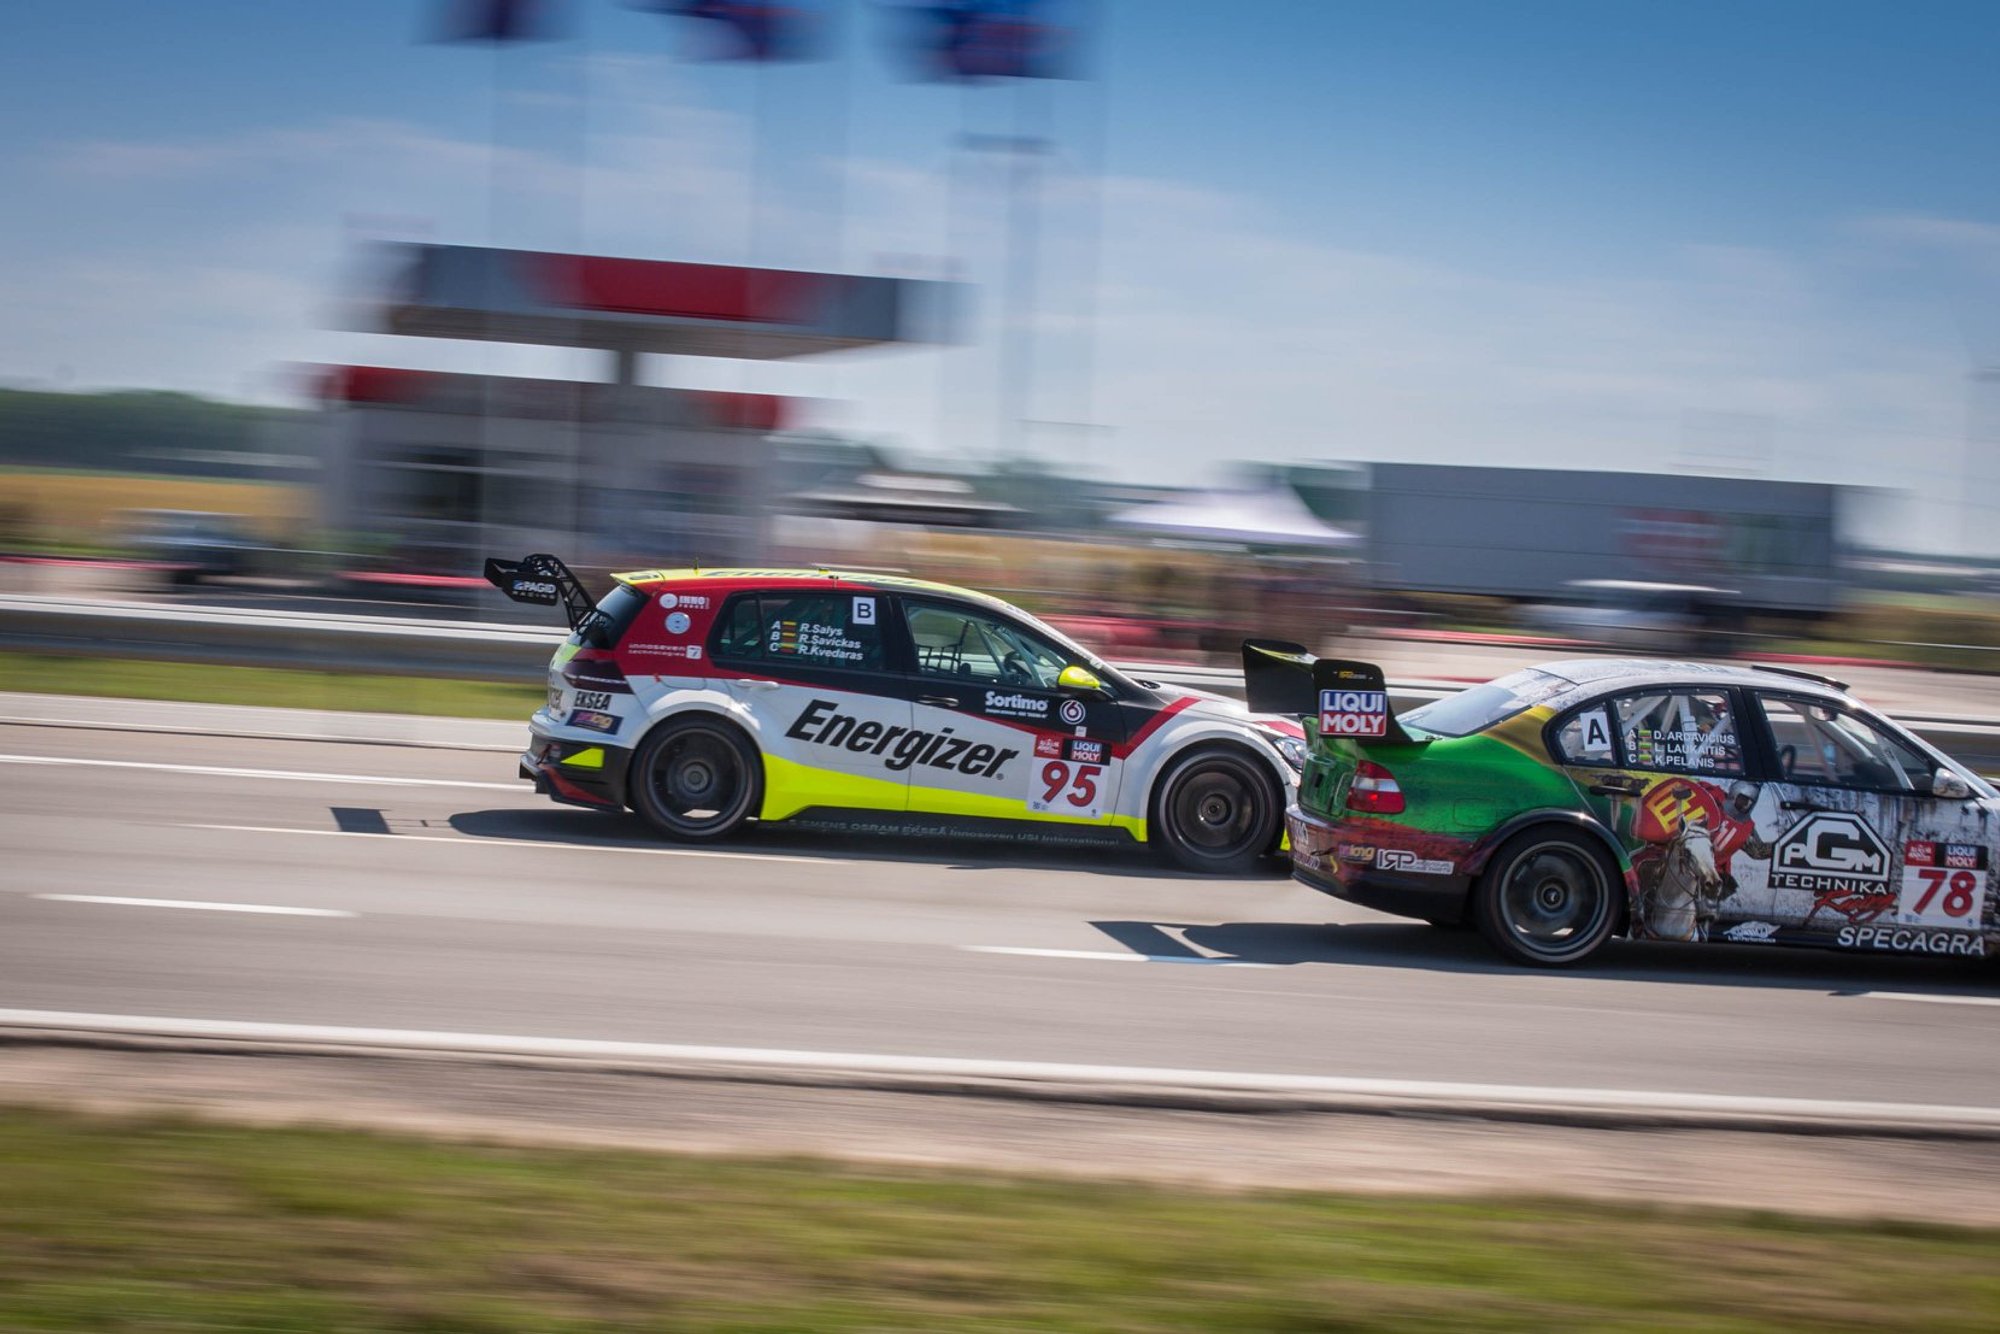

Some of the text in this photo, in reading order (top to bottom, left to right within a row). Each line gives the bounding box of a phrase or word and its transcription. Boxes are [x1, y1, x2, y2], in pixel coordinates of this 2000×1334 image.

[857, 603, 871, 619] B
[771, 620, 842, 637] A R.Salys
[770, 631, 862, 649] B R.Savickas
[769, 642, 863, 661] C R.Kvedaras
[574, 690, 612, 711] EKSEA
[985, 691, 1049, 712] Sortimo
[1323, 692, 1384, 712] LIQUI
[1322, 713, 1384, 733] MOLY
[1587, 718, 1607, 745] A
[1628, 729, 1637, 739] A
[1653, 731, 1665, 741] D.
[1073, 740, 1101, 753] LIQUI
[1628, 742, 1637, 751] B
[1667, 744, 1726, 756] LAUKAITIS
[1071, 751, 1100, 763] MOLY
[1628, 754, 1637, 764] C
[1042, 760, 1102, 808] 95
[1771, 873, 1888, 896] TECHNIKA
[1913, 868, 1977, 918] 78
[1837, 926, 1985, 956] SPECAGRA
